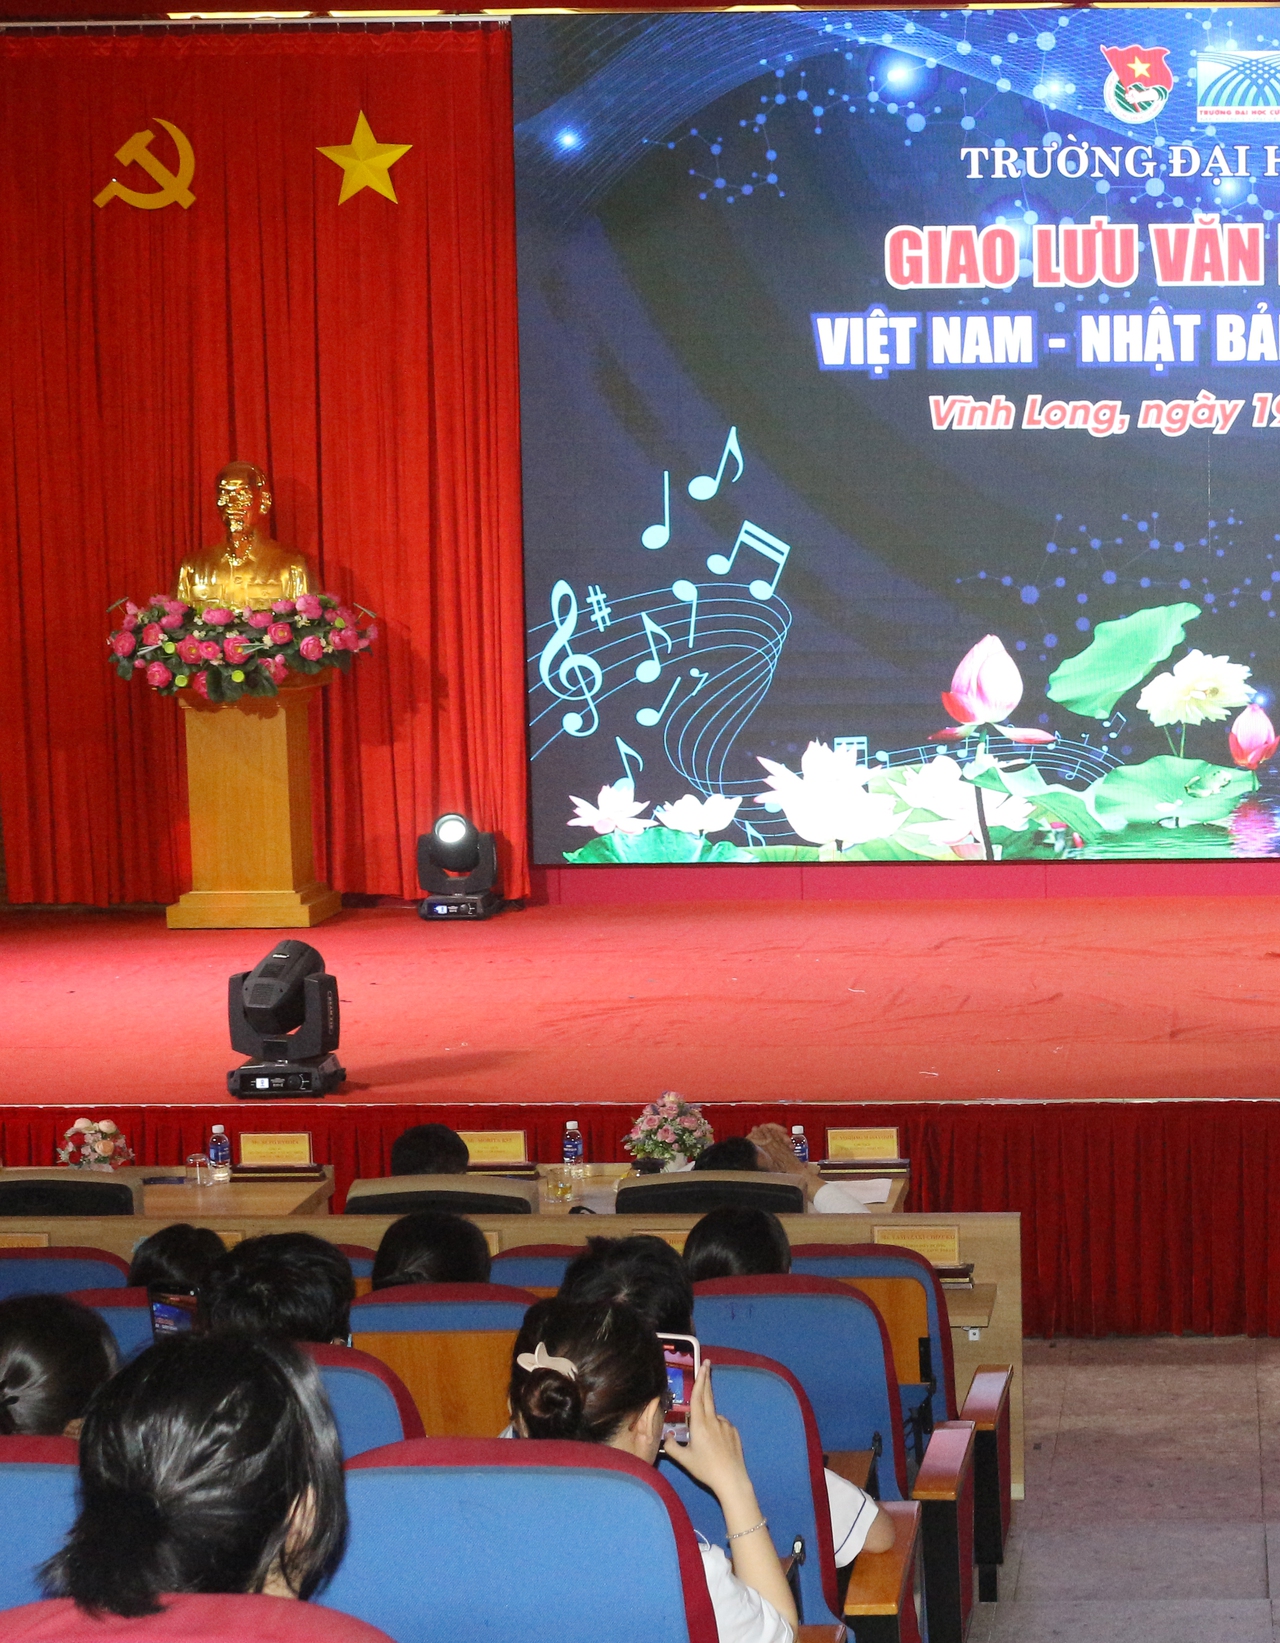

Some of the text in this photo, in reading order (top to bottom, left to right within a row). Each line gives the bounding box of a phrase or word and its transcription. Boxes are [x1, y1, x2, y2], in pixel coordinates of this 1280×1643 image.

[961, 134, 1157, 178] TRƯỜNG
[1169, 145, 1250, 186] ĐẠI
[885, 224, 1020, 290] GIAO
[1033, 216, 1139, 288] LƯU
[1148, 213, 1264, 287] VĂN
[817, 307, 916, 374] VIỆT
[933, 315, 1032, 364] NAM
[1049, 338, 1066, 349] -
[1081, 306, 1201, 372] NHẬT
[929, 394, 1016, 430] Vĩnh
[1022, 394, 1130, 437] Long,
[1137, 389, 1245, 437] ngày
